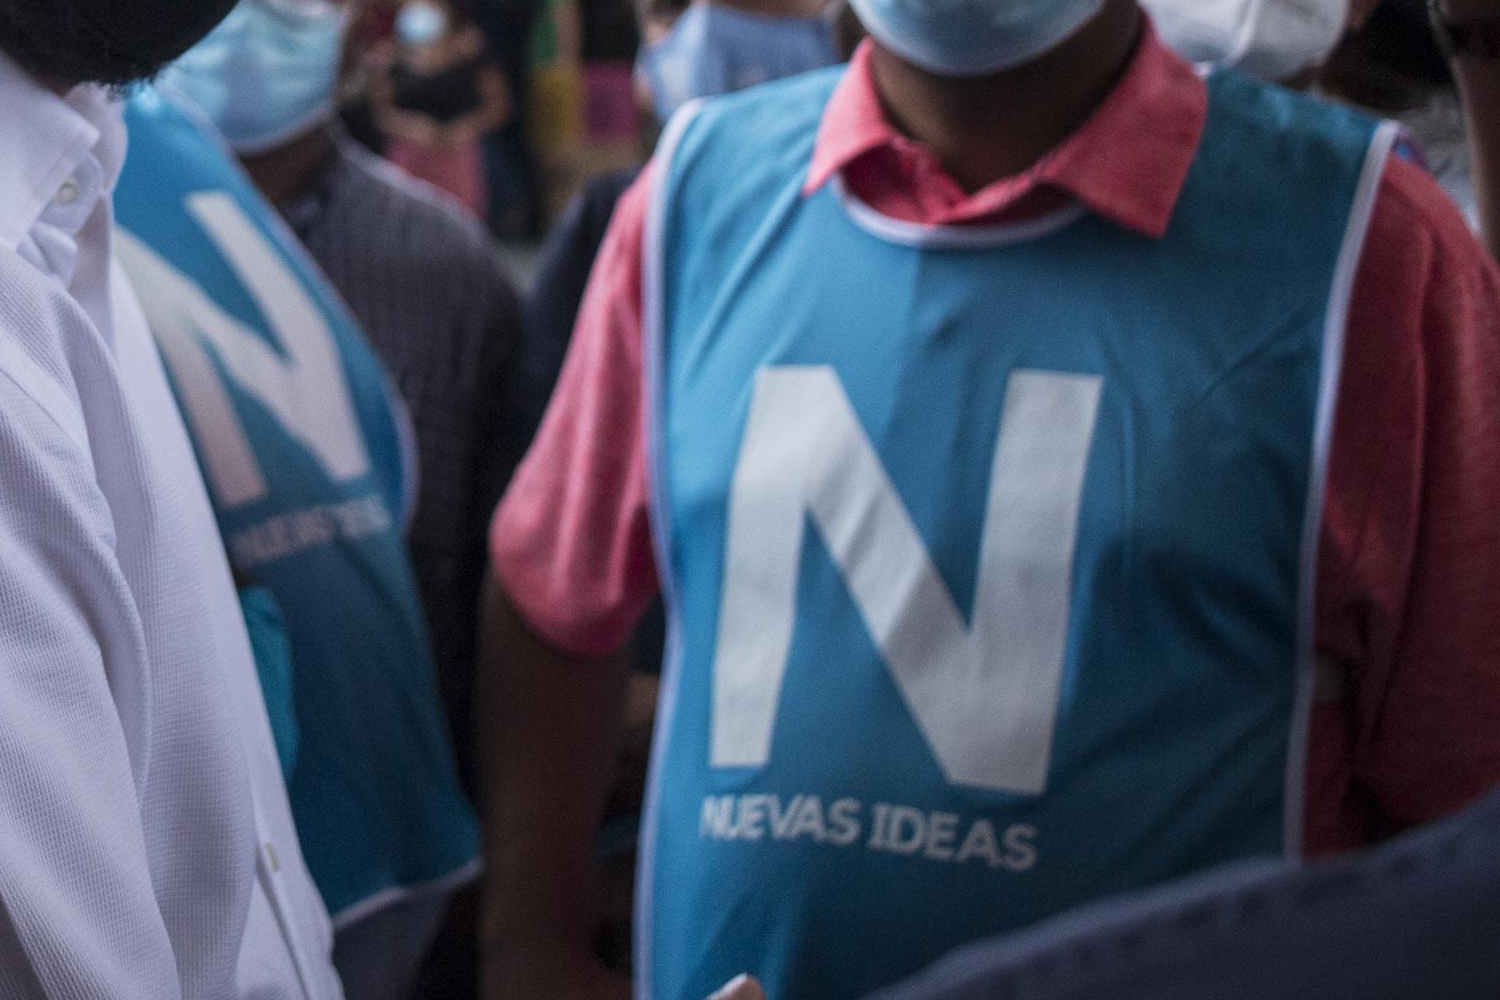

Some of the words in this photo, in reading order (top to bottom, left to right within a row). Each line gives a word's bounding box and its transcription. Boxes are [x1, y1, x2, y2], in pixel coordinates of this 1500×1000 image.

[113, 190, 370, 506] N
[710, 364, 1105, 795] N
[869, 803, 1039, 872] IDEAS
